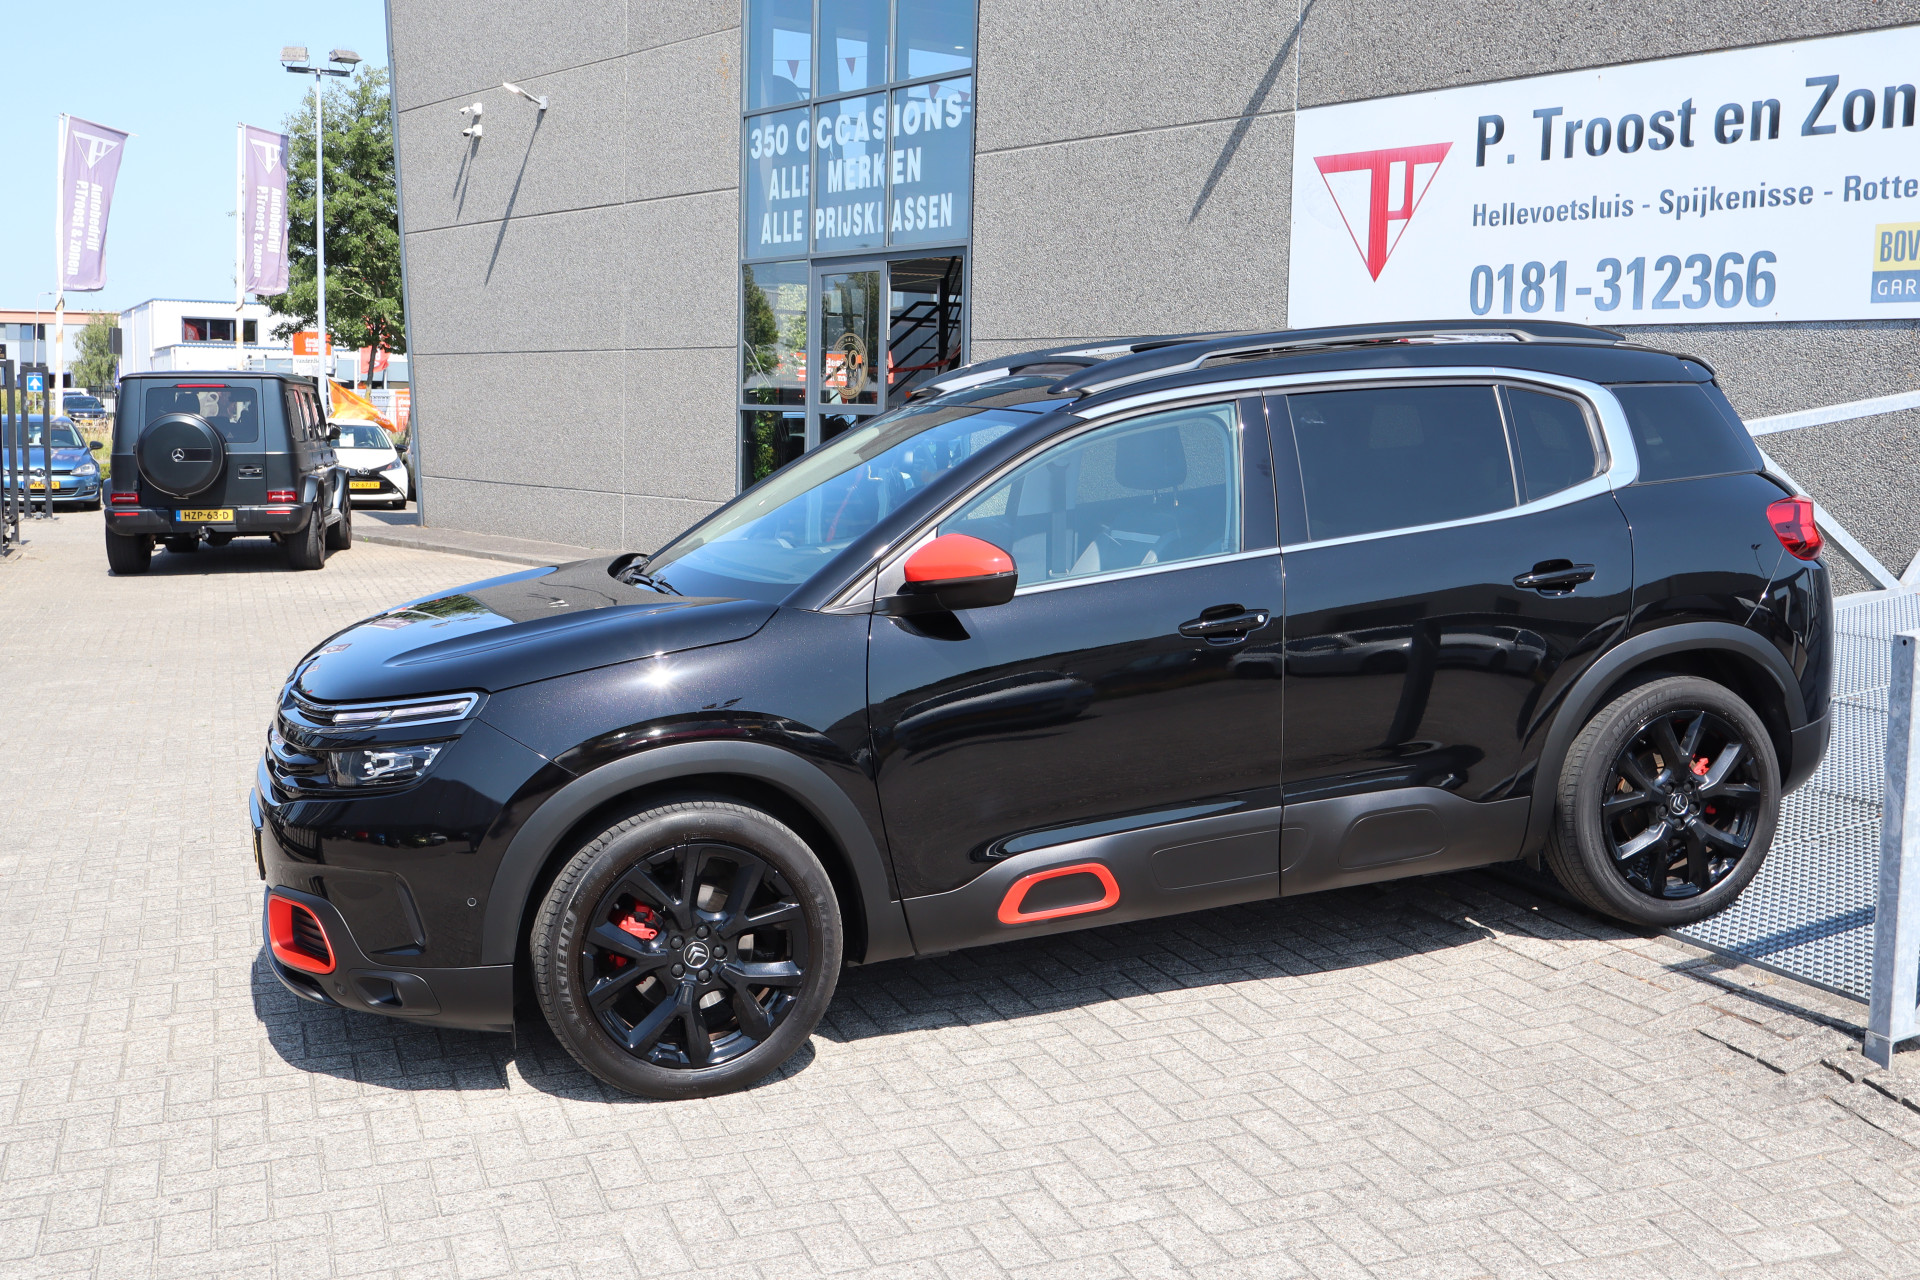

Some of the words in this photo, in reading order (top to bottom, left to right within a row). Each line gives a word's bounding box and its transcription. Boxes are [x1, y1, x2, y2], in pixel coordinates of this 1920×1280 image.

[750, 123, 789, 160] 350
[796, 93, 963, 154] OCCASIONS
[1476, 114, 1515, 168] P.
[1533, 98, 1697, 161] Troost
[1714, 98, 1781, 145] en
[1801, 74, 1917, 137] Zon
[769, 164, 810, 201] ALLE
[827, 147, 923, 194] MERKEN
[1472, 193, 1635, 227] Hellevoetsluis
[1658, 181, 1814, 221] Spijkenisse
[1843, 174, 1919, 204] Rotte
[71, 180, 89, 228] P.Troost
[85, 183, 103, 253] Autobedrijf
[266, 187, 283, 255] Autobedrijf
[760, 209, 803, 245] ALLE
[815, 192, 953, 240] PRIJSKLASSEN
[66, 239, 83, 276] zonen
[70, 229, 83, 239] &
[253, 233, 264, 242] &
[1468, 249, 1778, 316] 0181-312366
[1877, 278, 1917, 296] GAR
[184, 511, 229, 520] HZP-63-D
[556, 910, 578, 1018] MICHELIN
